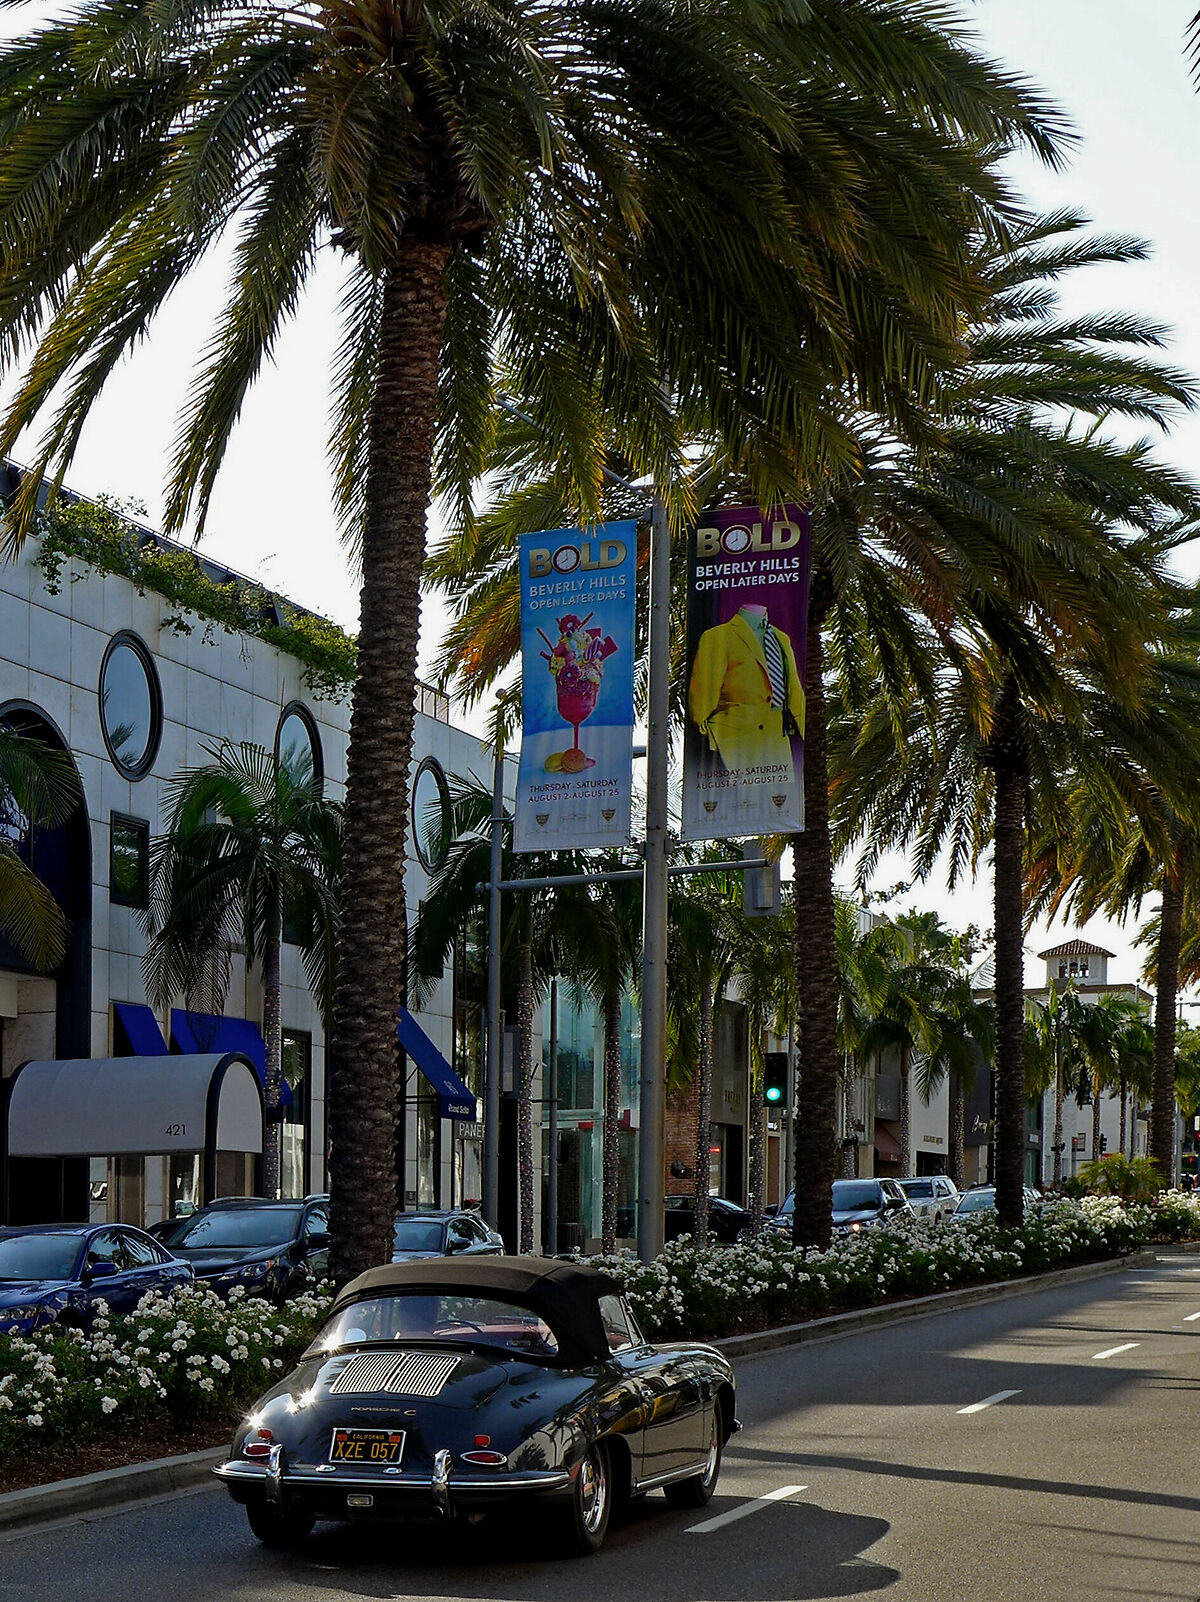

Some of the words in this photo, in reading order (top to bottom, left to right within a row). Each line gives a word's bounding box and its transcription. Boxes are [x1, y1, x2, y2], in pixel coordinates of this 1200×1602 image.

[696, 521, 802, 558] BOLD
[529, 539, 627, 578] BOLD
[695, 560, 757, 578] BEVERLY
[760, 557, 800, 571] HILLS
[530, 579, 585, 597] BEVERLY
[590, 574, 626, 589] HILLS
[695, 578, 729, 591] OPEN
[731, 575, 766, 588] LATER
[768, 572, 800, 584] DAYS
[529, 598, 560, 610] OPEN
[562, 593, 594, 606] LATER
[597, 589, 626, 601] DAYS
[696, 769, 740, 779] THURSDAY
[746, 764, 788, 776] SATURDAY
[530, 783, 571, 793] THURSDAY
[576, 779, 618, 789] SATURDAY
[696, 780, 730, 790] AUGUST
[742, 775, 776, 785] AUGUST
[528, 793, 561, 803] AUGUST
[572, 789, 606, 799] AUGUST
[608, 788, 620, 796] 25
[165, 1124, 186, 1136] 421
[335, 1441, 366, 1458] XZE
[370, 1442, 399, 1459] 057
